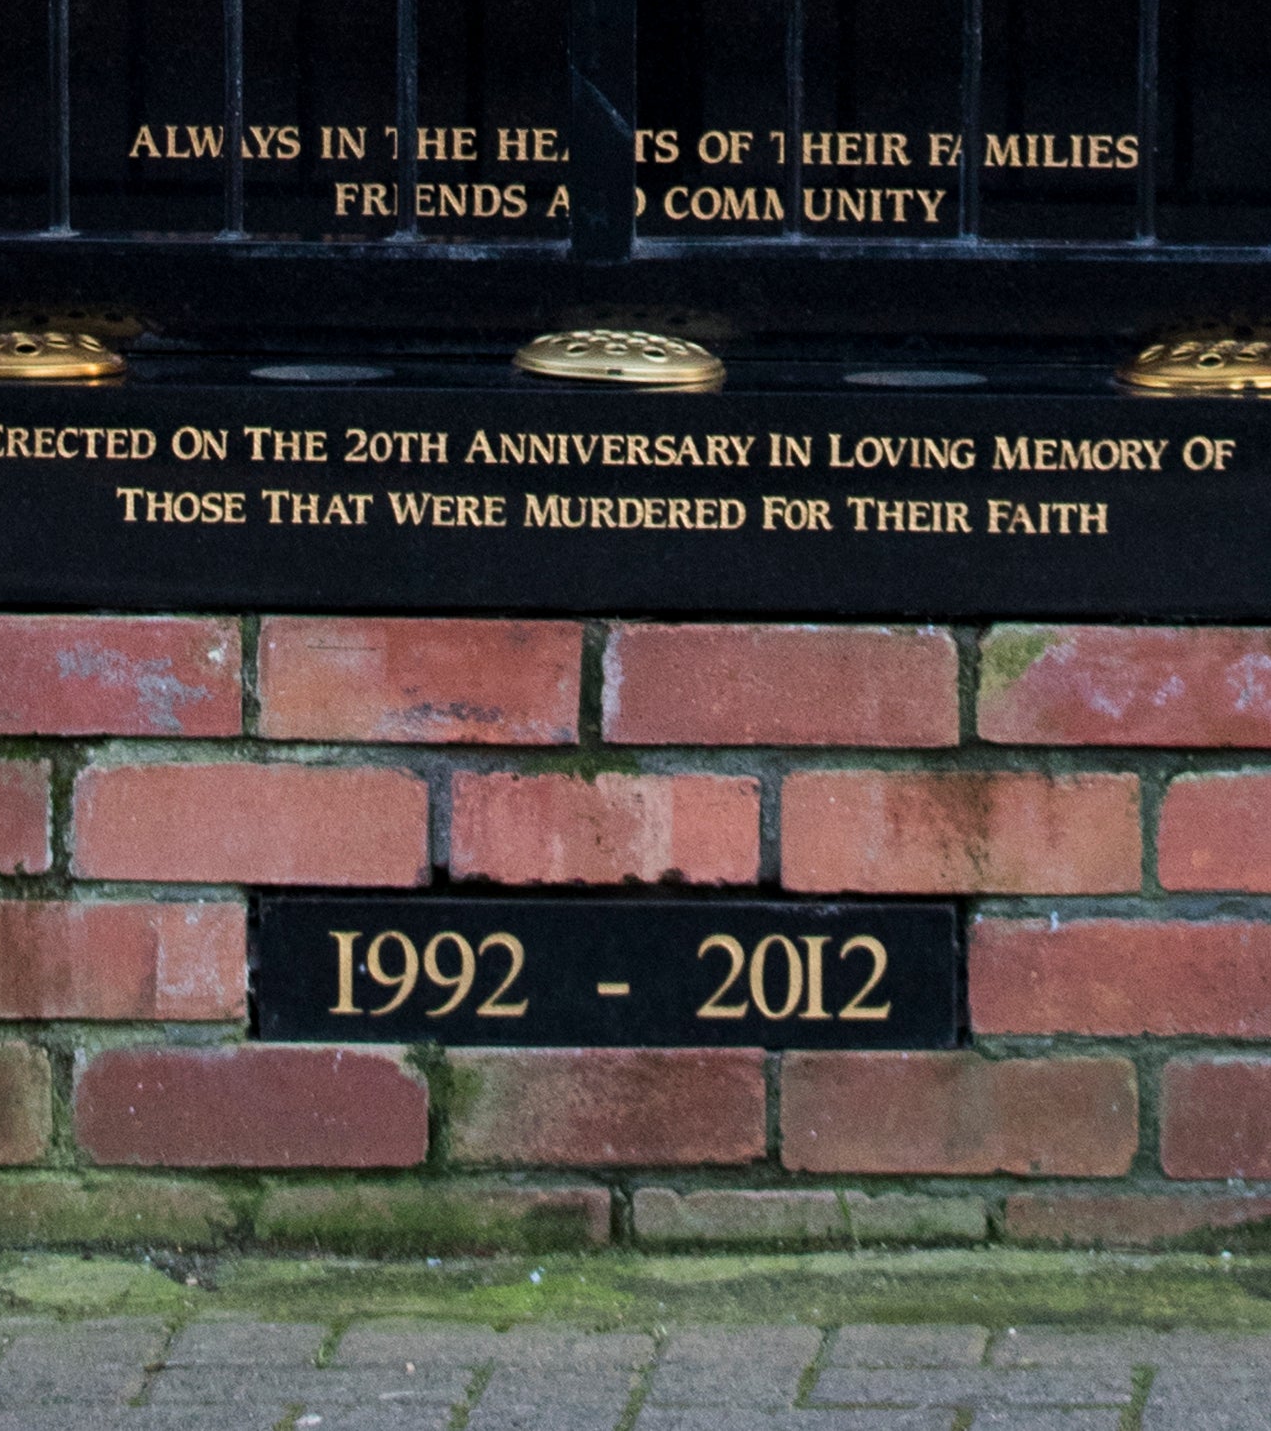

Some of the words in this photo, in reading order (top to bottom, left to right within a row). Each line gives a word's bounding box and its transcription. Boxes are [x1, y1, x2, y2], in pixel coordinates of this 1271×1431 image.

[321, 126, 366, 160] IN
[497, 127, 679, 163] HETS
[698, 130, 753, 164] OF
[172, 427, 228, 460] ON
[244, 427, 327, 461] THE
[345, 429, 447, 462] 20TH
[465, 430, 755, 466] ANNIVERSARY
[770, 434, 812, 466] IN
[829, 434, 975, 469] LOVING
[993, 437, 1168, 470] MEMORY
[1183, 436, 1235, 470] OF
[117, 488, 245, 523] THOSE
[262, 490, 373, 524] THAT
[388, 492, 506, 526] WERE
[524, 494, 746, 529] MURDERED
[763, 497, 833, 530] FOR
[848, 497, 972, 533] THEIR
[988, 500, 1107, 533] FAITH
[330, 931, 528, 1016] 1992
[697, 935, 890, 1019] 2012
